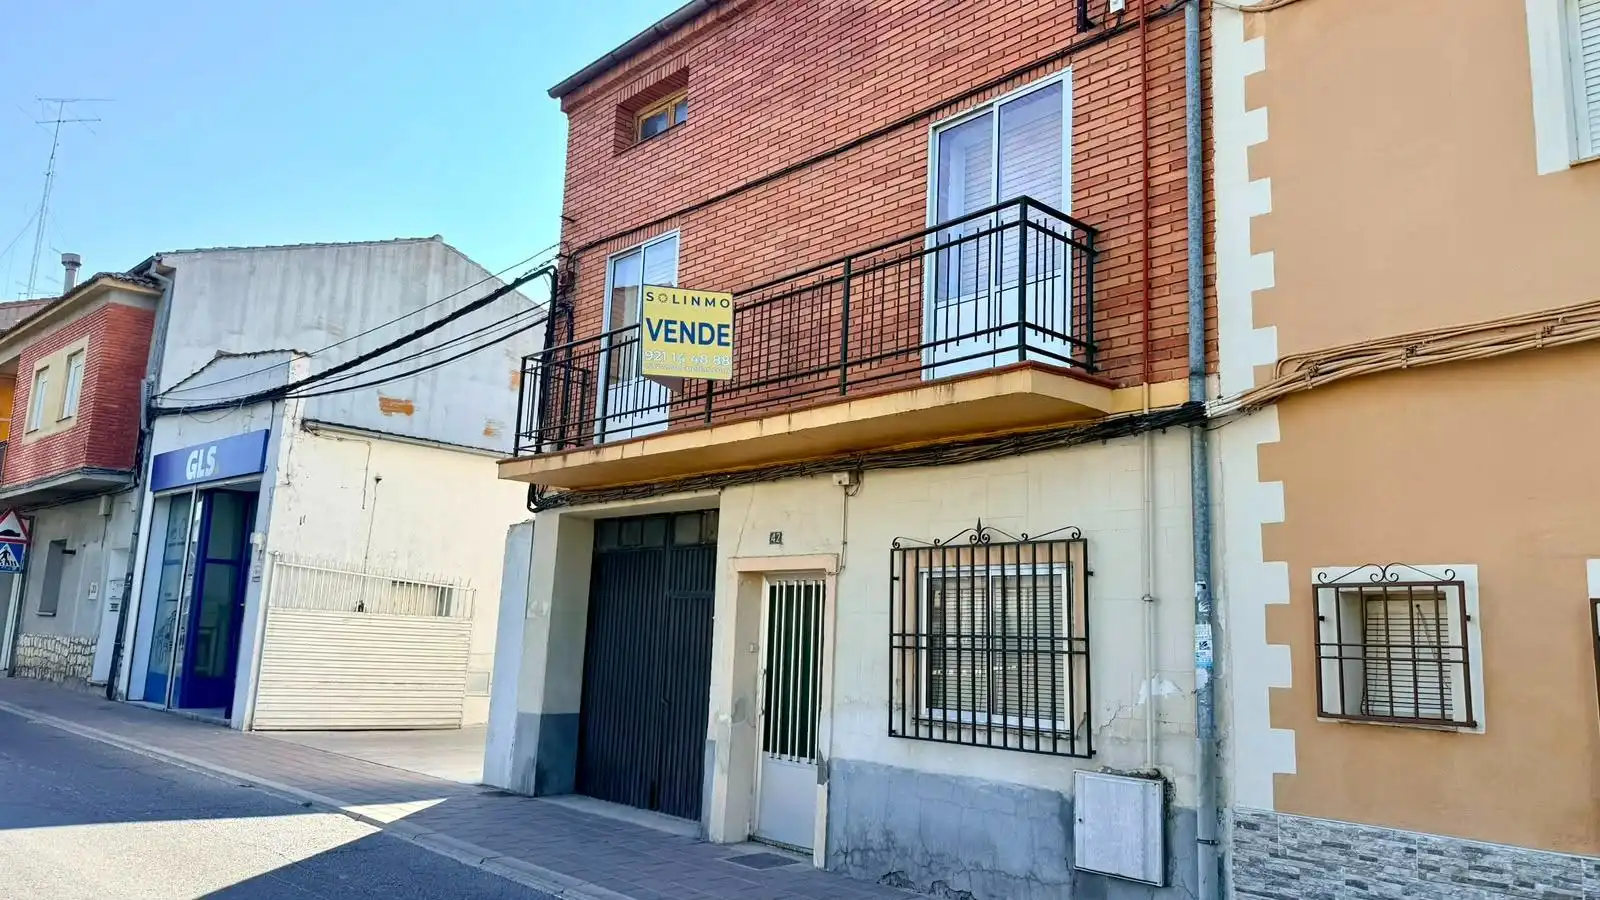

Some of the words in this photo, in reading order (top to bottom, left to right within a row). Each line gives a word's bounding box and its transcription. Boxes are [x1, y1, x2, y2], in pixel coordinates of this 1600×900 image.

[646, 291, 730, 308] SOLINMO
[645, 317, 731, 347] VENDE
[645, 350, 666, 361] 921
[713, 355, 730, 366] 88
[185, 445, 218, 481] GLS
